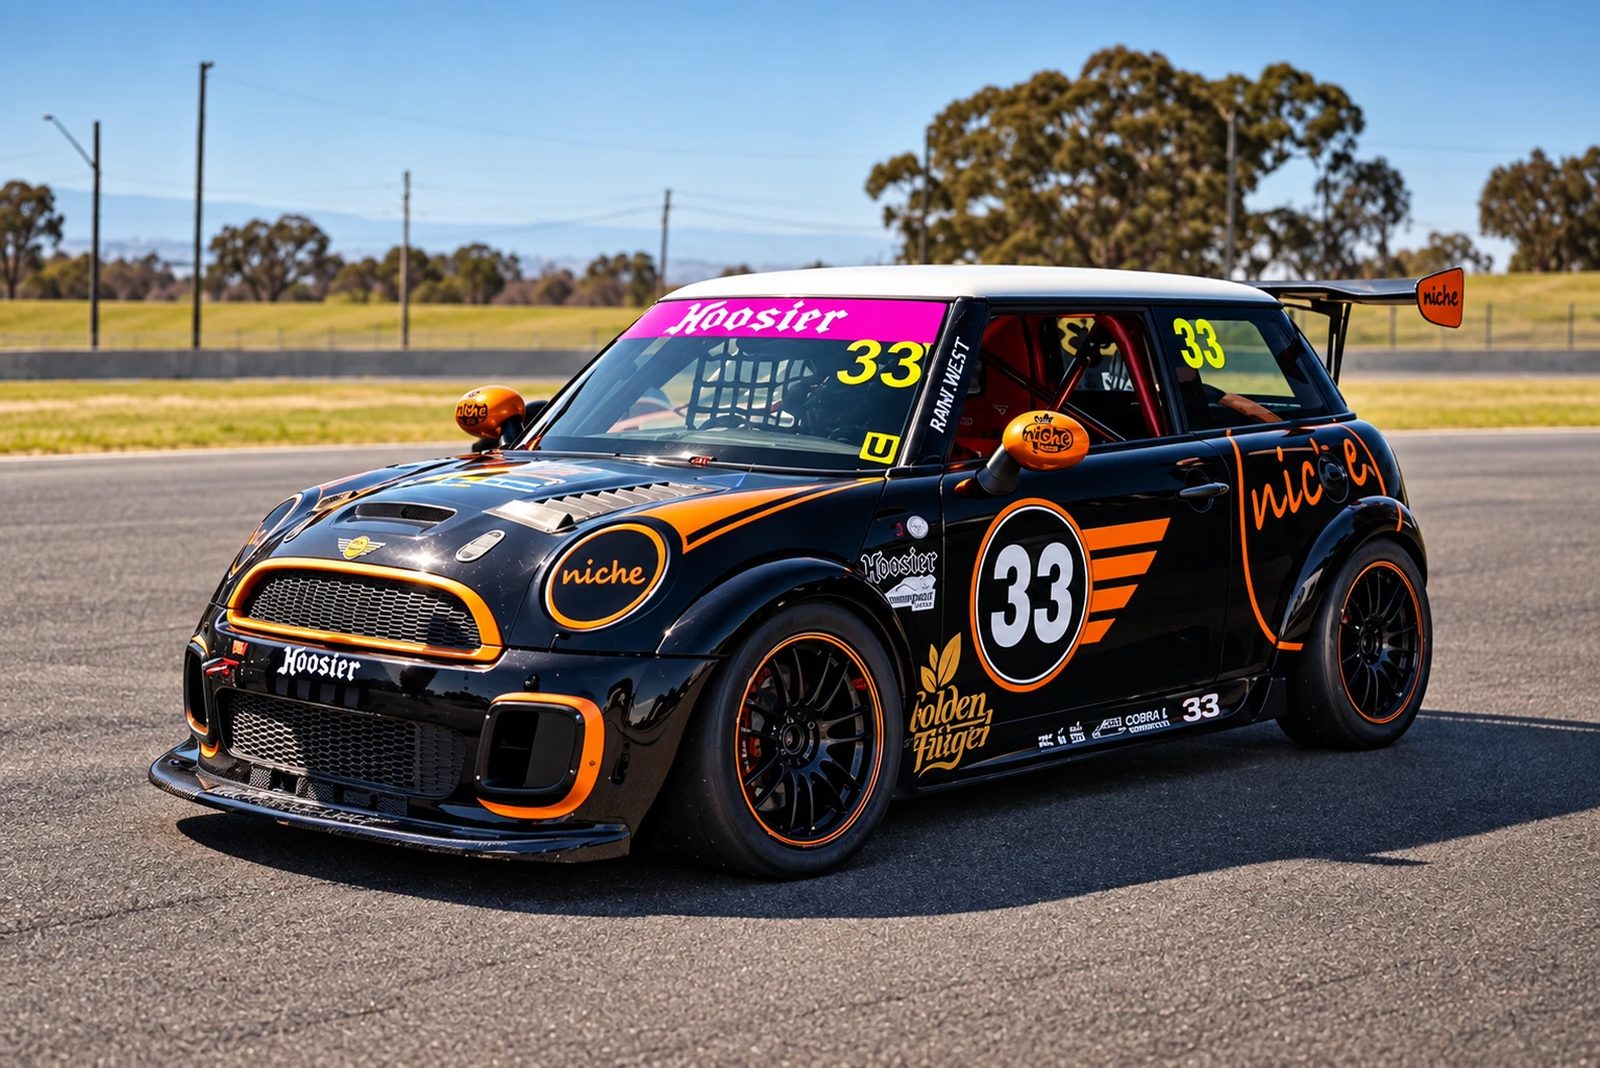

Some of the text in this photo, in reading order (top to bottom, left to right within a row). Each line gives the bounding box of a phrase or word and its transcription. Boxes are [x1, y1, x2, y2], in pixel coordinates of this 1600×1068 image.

[1423, 284, 1459, 307] niche
[663, 300, 849, 336] Hoosier
[1173, 318, 1227, 370] 33
[837, 339, 925, 388] 33
[867, 436, 895, 459] U
[562, 558, 646, 585] niche
[860, 546, 938, 585] Hoosier
[990, 542, 1074, 648] 33
[276, 646, 361, 682] Hoosier
[1125, 709, 1160, 727] COBRA
[1182, 693, 1221, 723] 33
